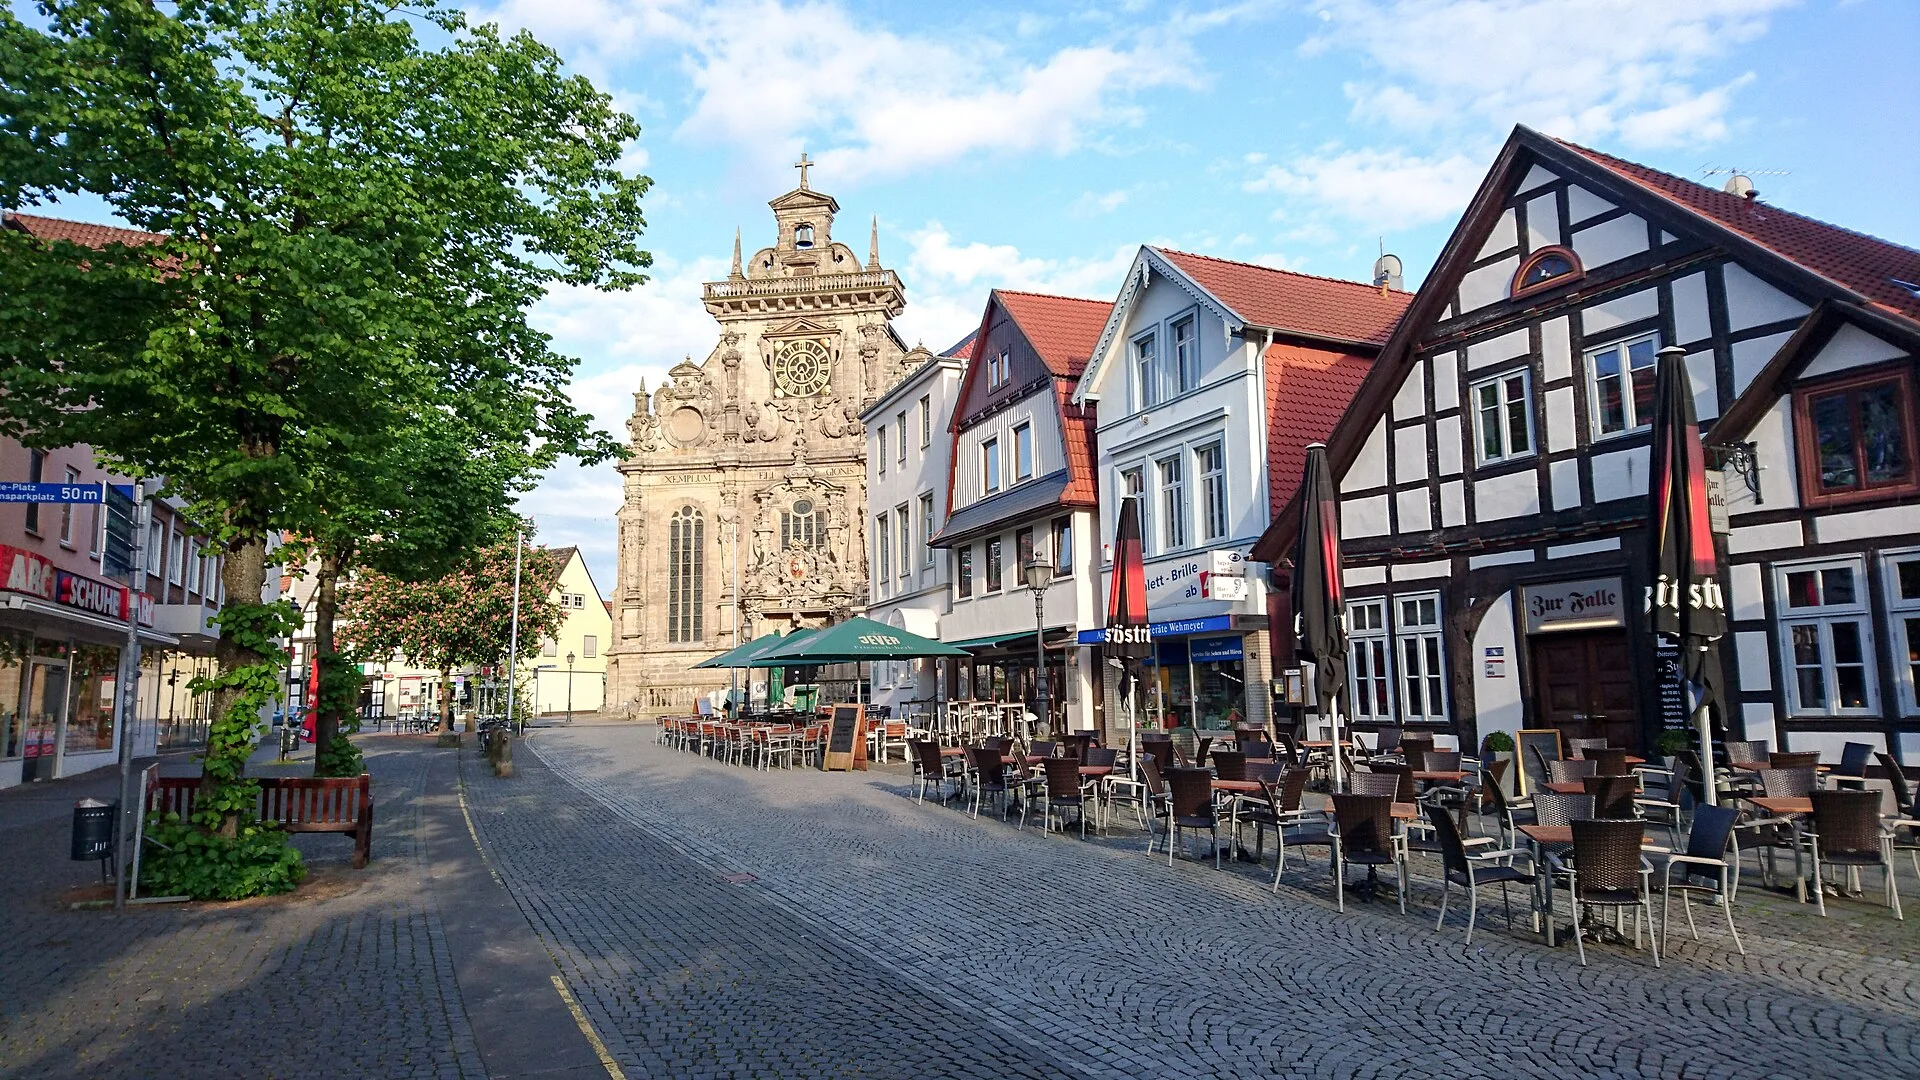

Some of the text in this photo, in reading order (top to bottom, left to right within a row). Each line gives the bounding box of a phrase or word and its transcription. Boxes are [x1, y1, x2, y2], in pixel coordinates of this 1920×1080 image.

[61, 488, 98, 500] 50 m
[1709, 494, 1724, 506] alle
[7, 554, 50, 598] ABC
[1145, 575, 1164, 592] lett
[1171, 562, 1198, 582] Brille
[69, 576, 120, 617] SCHUHE
[1185, 585, 1198, 598] ab
[1531, 589, 1616, 617] Zur Falle
[1168, 621, 1204, 632] Wehmeyer
[858, 636, 900, 645] JEVER
